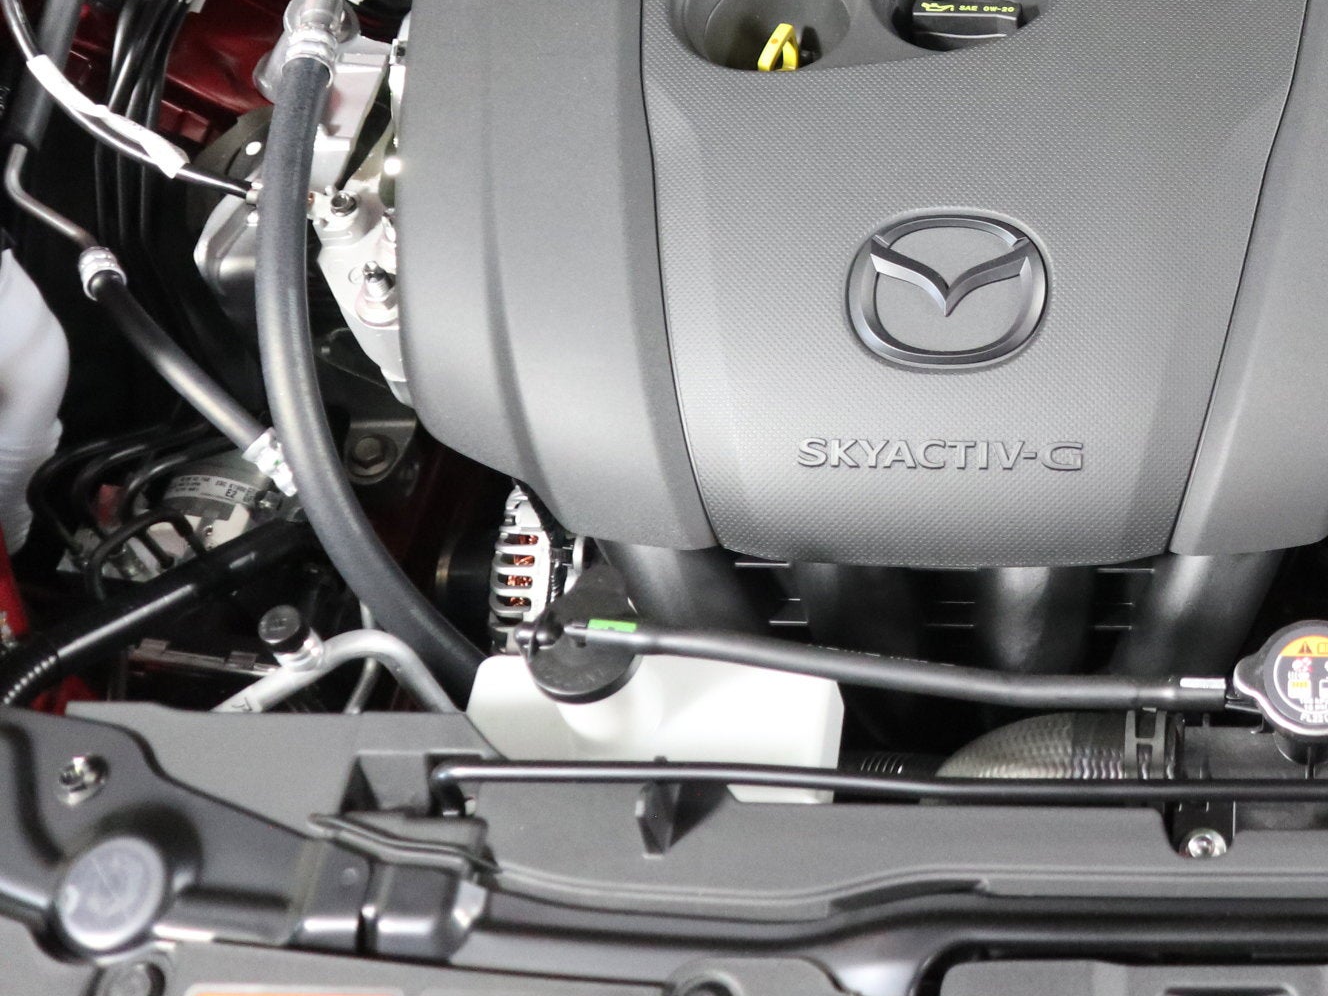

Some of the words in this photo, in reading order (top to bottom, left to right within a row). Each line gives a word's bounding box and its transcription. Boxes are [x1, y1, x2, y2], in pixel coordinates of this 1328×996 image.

[958, 4, 979, 12] SAE
[982, 5, 1015, 13] 0W-20
[797, 436, 1084, 472] SKYACTIV-G
